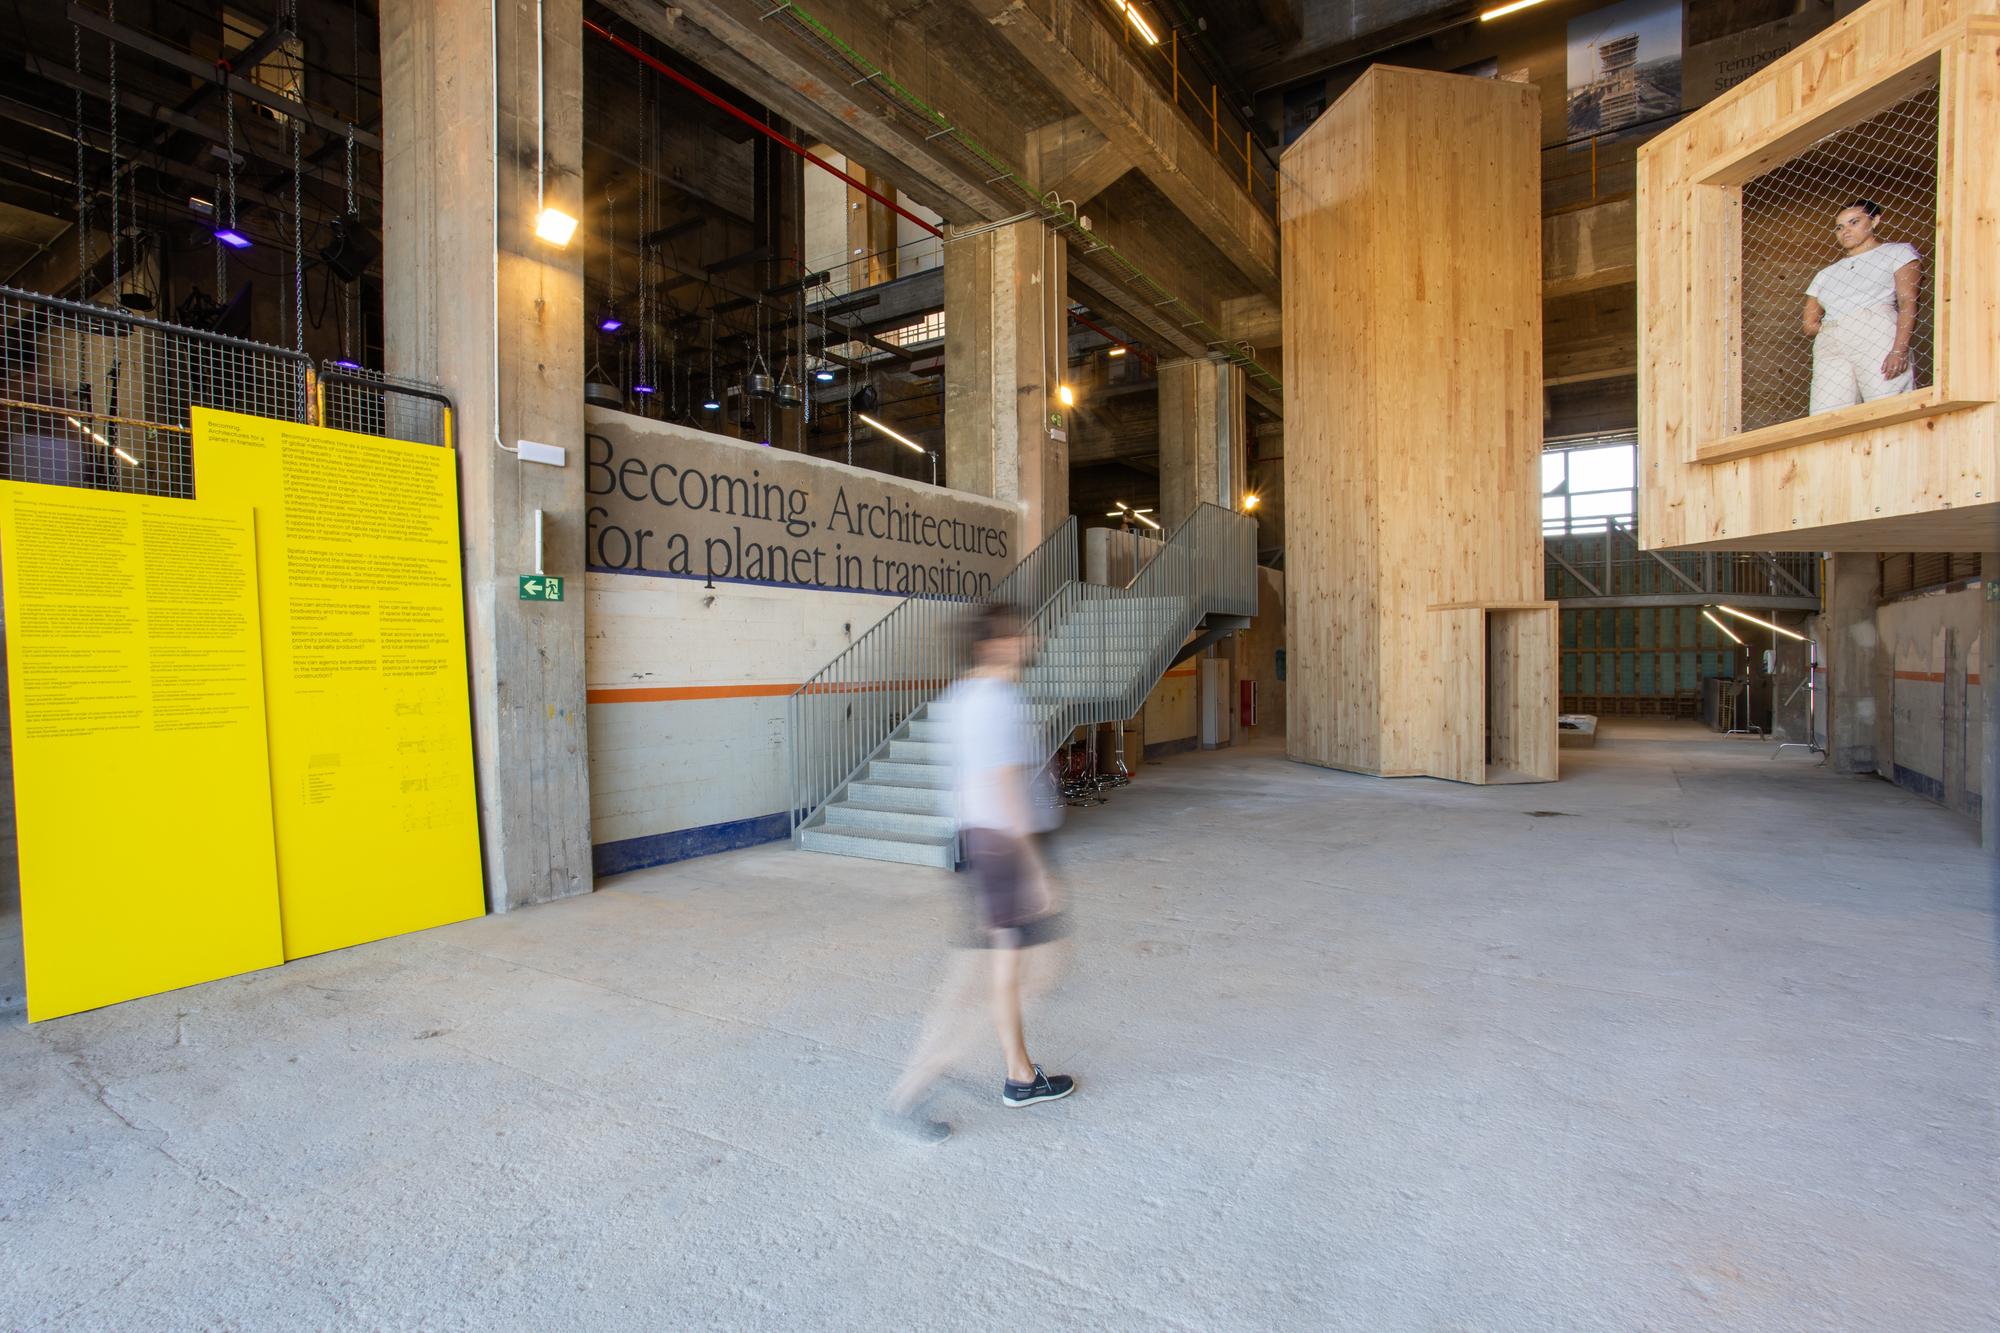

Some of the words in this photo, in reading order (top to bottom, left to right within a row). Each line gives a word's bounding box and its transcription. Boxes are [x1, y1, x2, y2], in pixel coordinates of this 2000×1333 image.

[1715, 42, 1791, 74] Temporal
[208, 420, 242, 432] Becoming.
[208, 428, 250, 439] Architectures
[208, 435, 228, 444] planet
[237, 439, 267, 448] transition.
[281, 432, 310, 443] Becoming
[311, 437, 336, 445] activates
[360, 444, 386, 454] projective
[387, 449, 403, 457] design
[586, 433, 816, 537] Becoming.
[827, 486, 1007, 558] Architectures
[586, 506, 653, 571] for
[667, 533, 693, 575] a
[704, 527, 826, 588] planet
[835, 543, 864, 590] in
